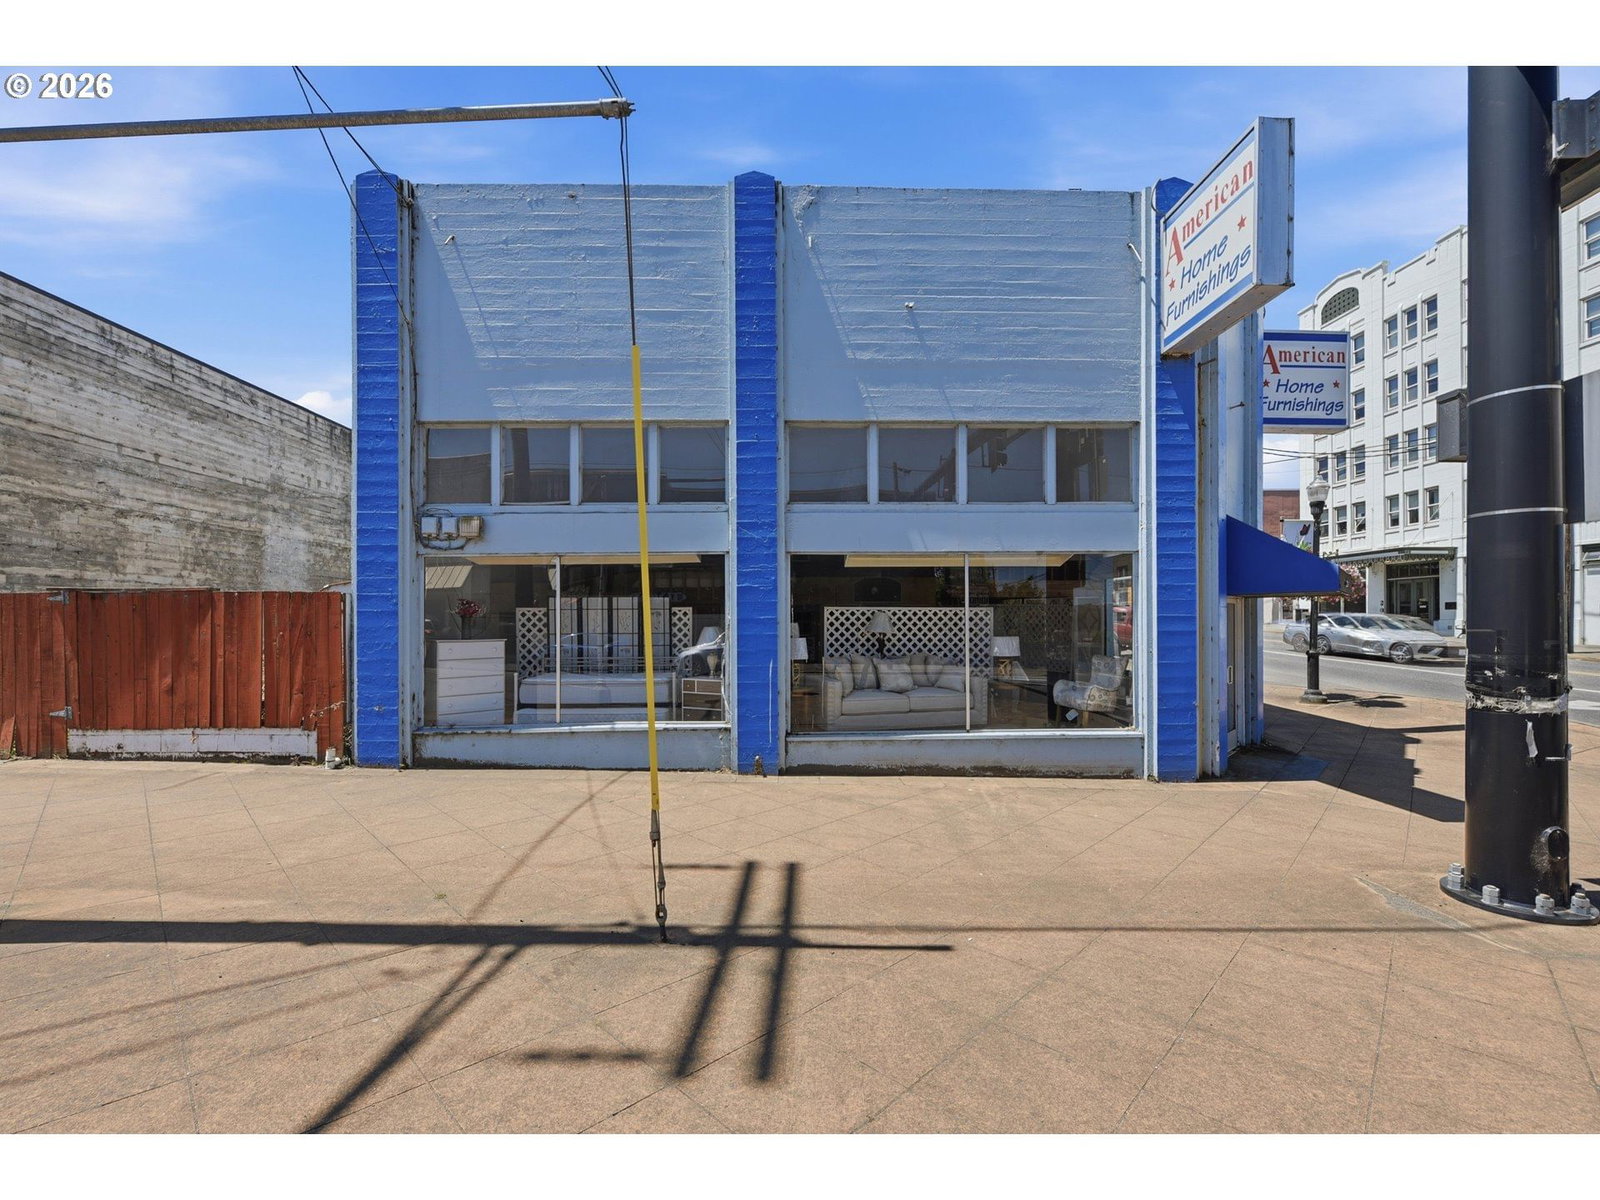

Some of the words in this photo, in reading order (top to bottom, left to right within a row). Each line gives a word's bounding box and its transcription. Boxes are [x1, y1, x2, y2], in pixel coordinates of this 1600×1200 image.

[1166, 160, 1253, 277] American
[1166, 244, 1252, 327] Furnishings
[1181, 235, 1229, 289] Home
[1263, 344, 1346, 375] American
[1276, 379, 1324, 394] Home
